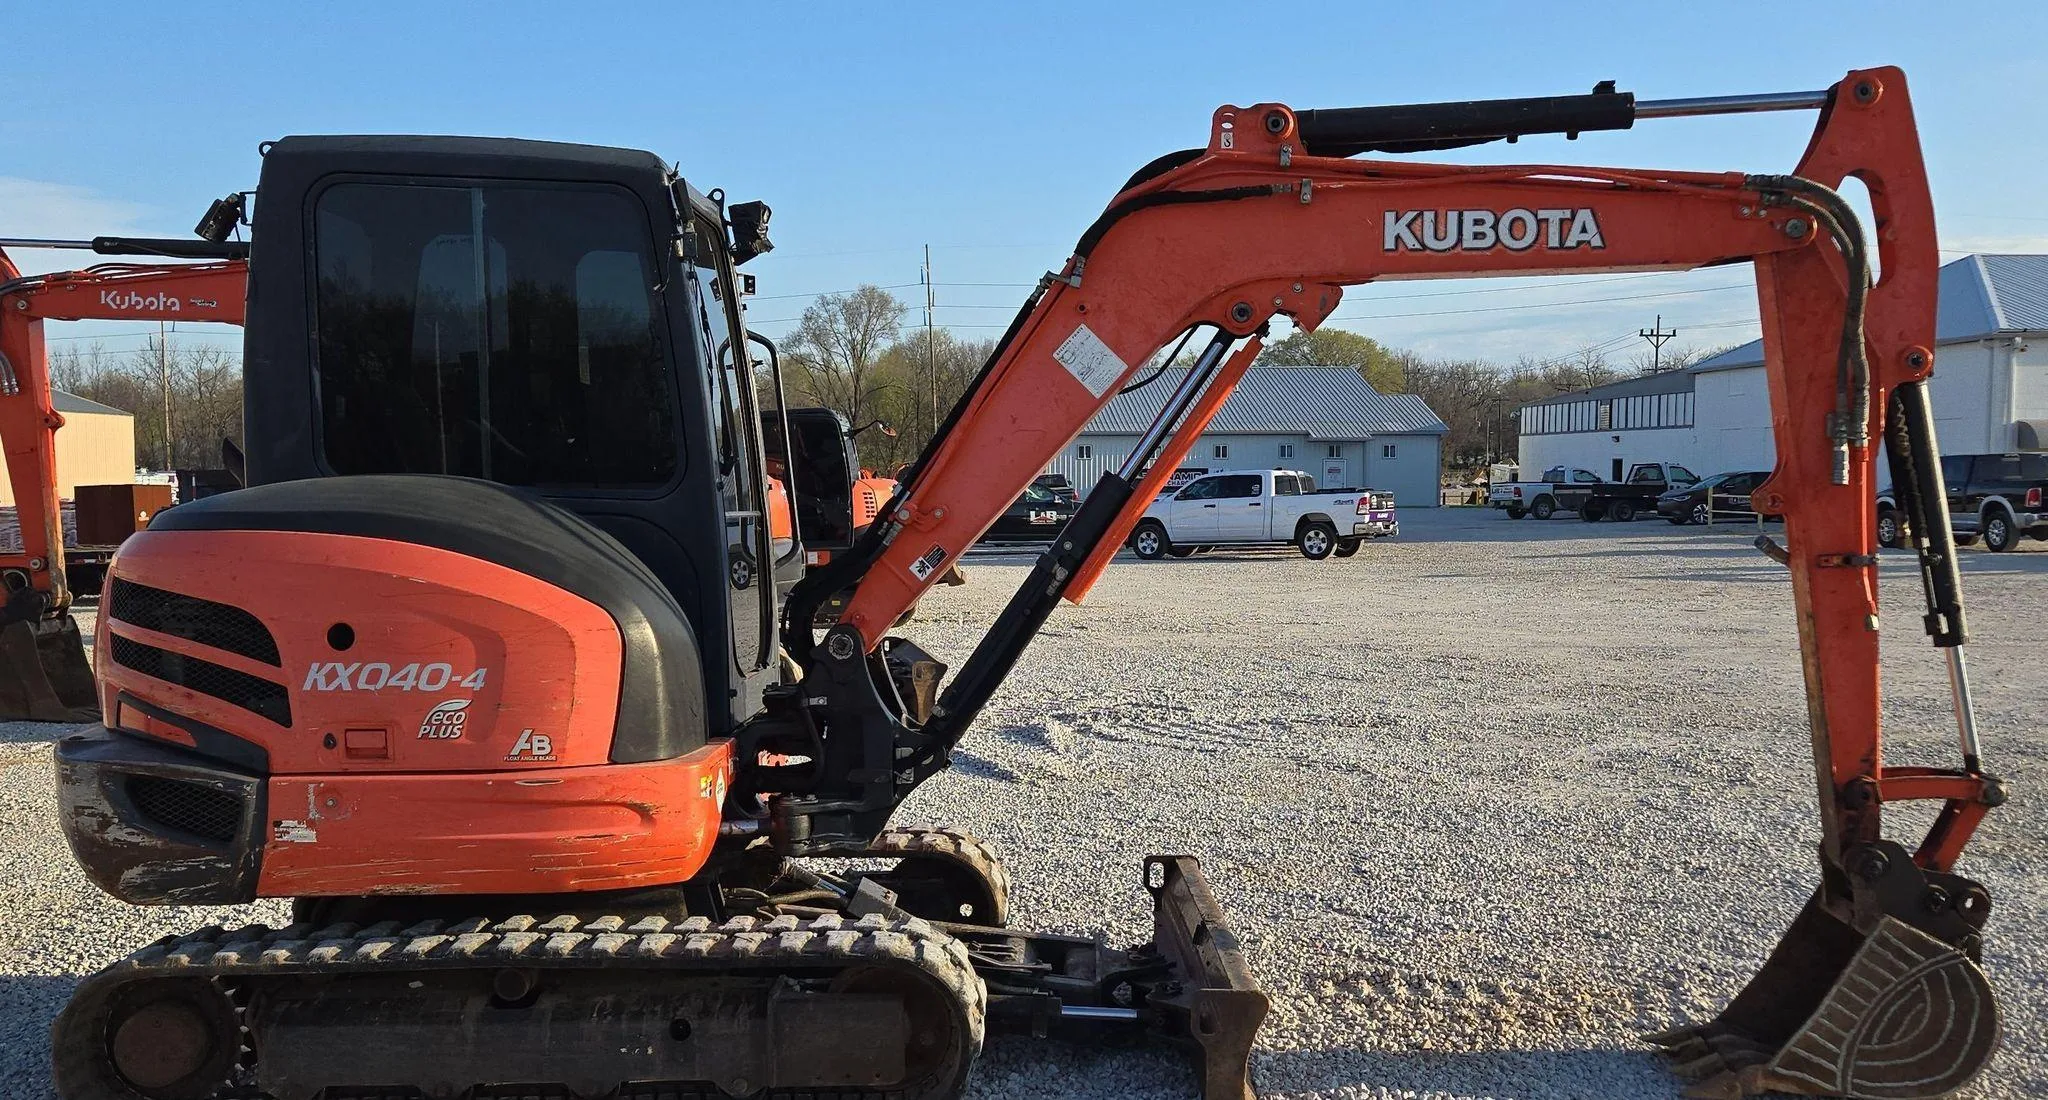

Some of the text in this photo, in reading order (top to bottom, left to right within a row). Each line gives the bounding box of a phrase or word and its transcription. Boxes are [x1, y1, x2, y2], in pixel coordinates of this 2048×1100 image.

[1383, 208, 1605, 251] KUBOTA
[100, 290, 180, 311] Kubota
[432, 711, 466, 725] eco
[417, 724, 464, 739] PLUS
